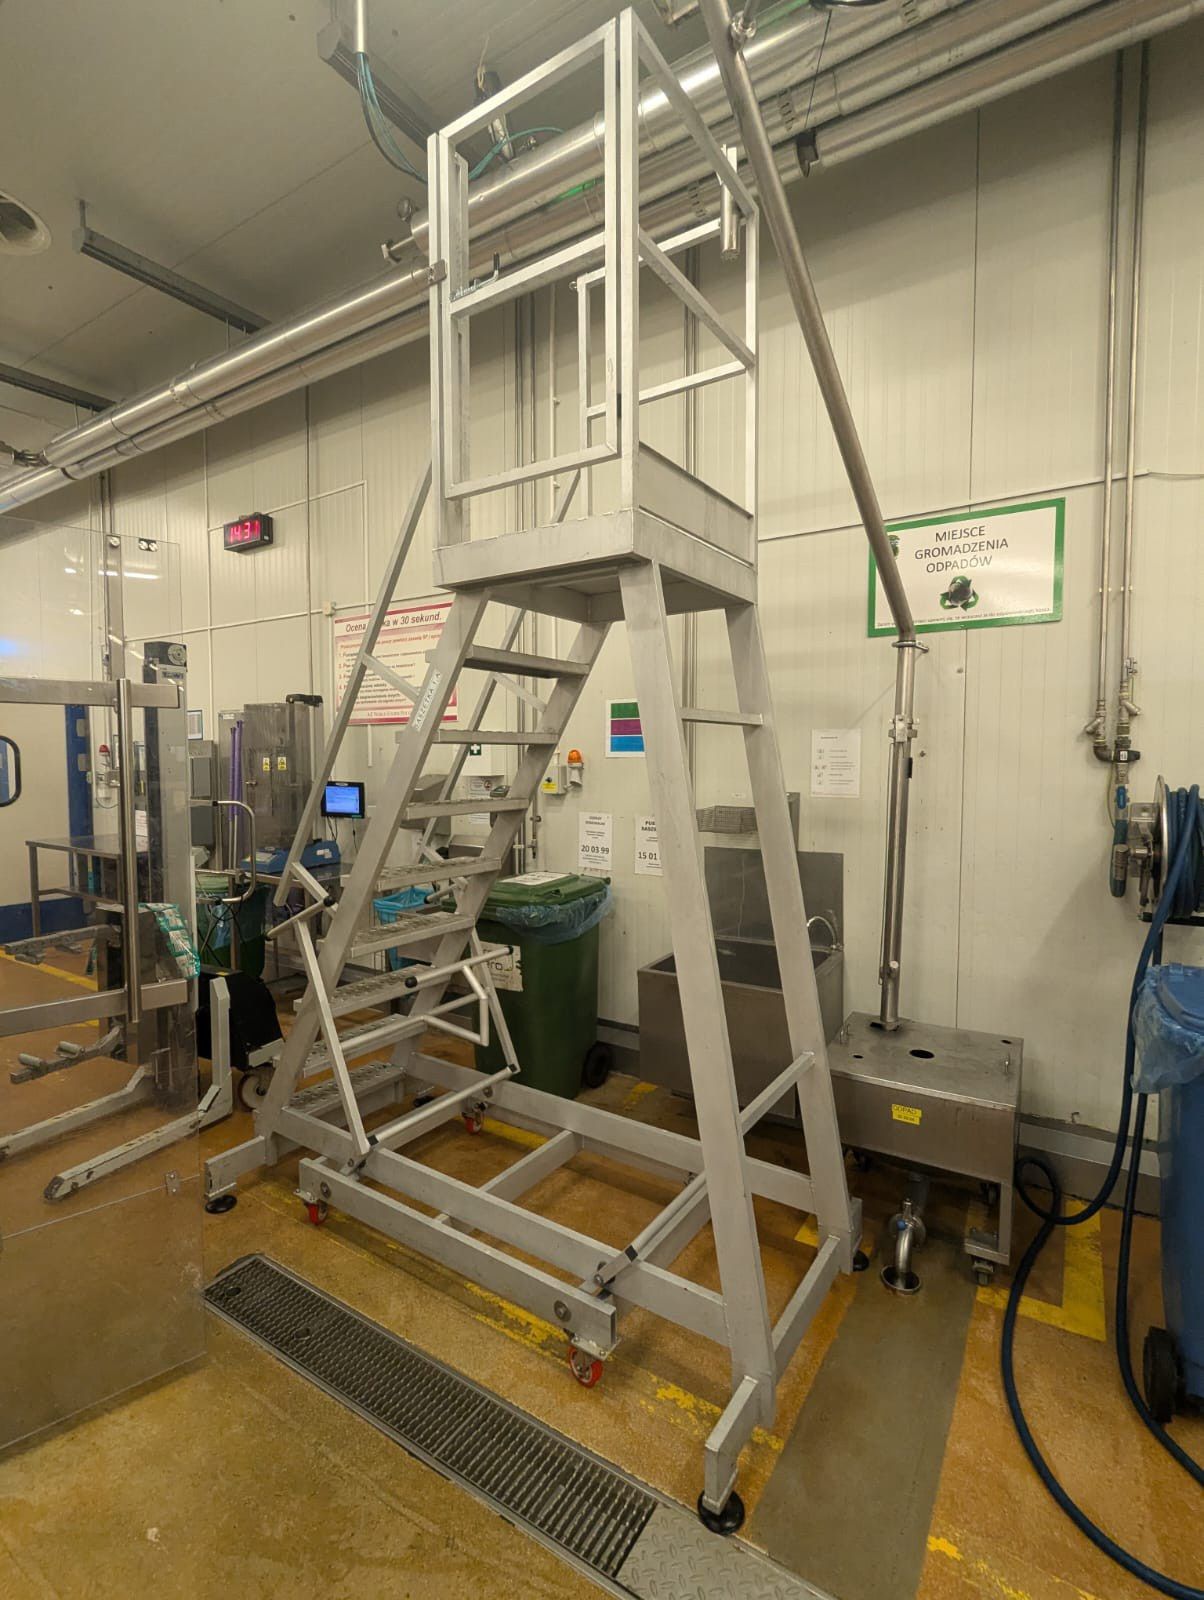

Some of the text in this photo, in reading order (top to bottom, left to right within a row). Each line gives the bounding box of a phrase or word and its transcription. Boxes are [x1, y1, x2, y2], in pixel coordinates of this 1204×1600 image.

[935, 525, 986, 542] MIEJSCE
[915, 538, 1009, 559] GROMADZENIA
[926, 555, 993, 573] ODPADÓW
[345, 622, 367, 633] Ocena
[392, 619, 399, 627] w
[400, 615, 410, 625] 30
[410, 611, 442, 624] sekund.
[581, 844, 610, 855] 20 03 99
[638, 851, 658, 861] 15 01
